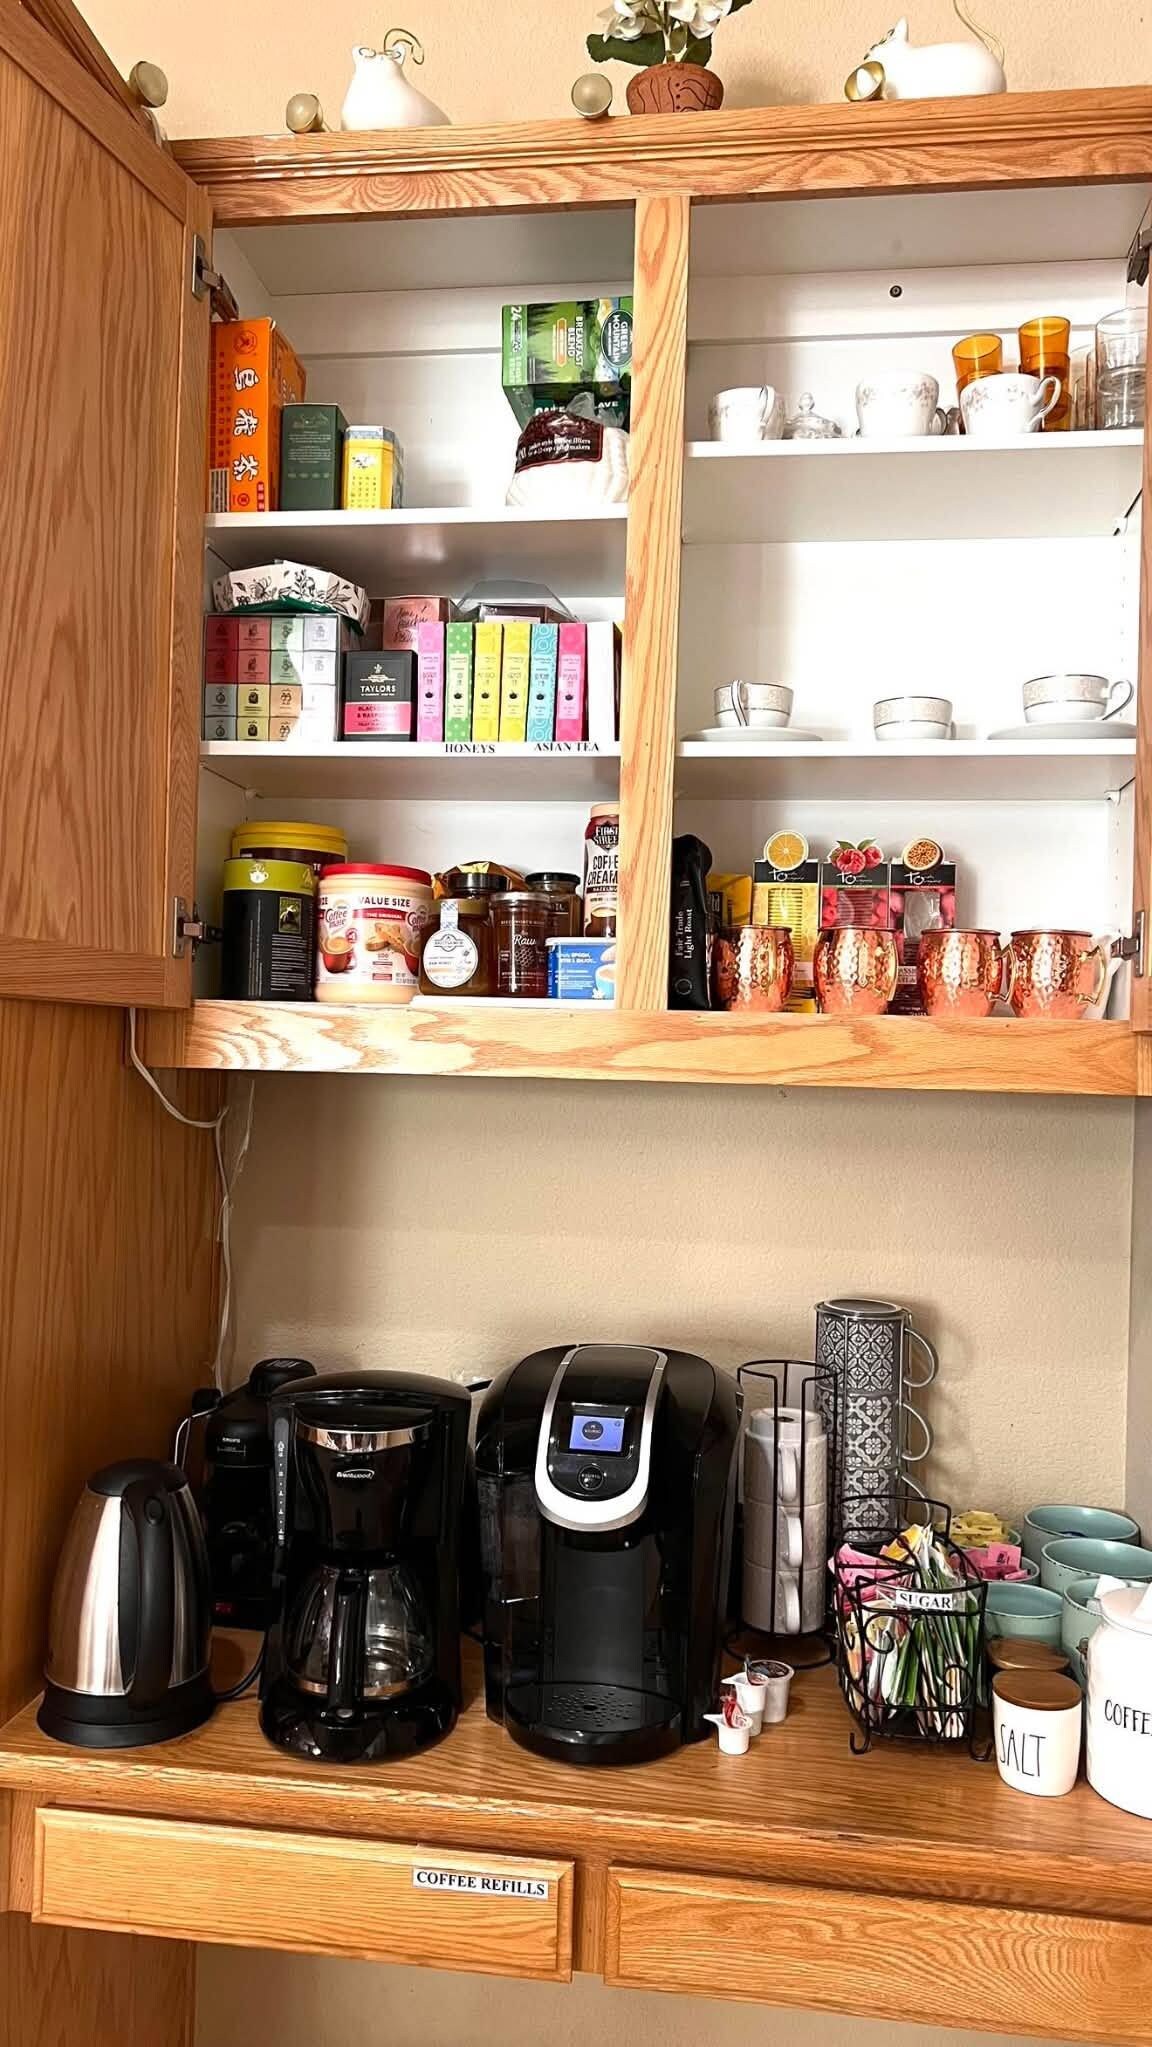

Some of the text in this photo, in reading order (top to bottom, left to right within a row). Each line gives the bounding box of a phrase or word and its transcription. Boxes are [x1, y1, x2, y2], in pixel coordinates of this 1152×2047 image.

[510, 305, 522, 321] 24
[575, 316, 584, 367] BREAKFAST
[613, 314, 621, 364] MOUNTAIN
[621, 321, 629, 354] GREEN
[360, 685, 397, 693] TAYLORS
[445, 743, 496, 754] HONEYS
[534, 742, 600, 752] ASIAN TEA
[360, 896, 411, 908] VALUE SIZE
[325, 908, 348, 923] Coffee
[514, 934, 537, 945] Raw
[674, 911, 684, 956] Fair Trade
[684, 908, 695, 959] Light Roast
[336, 1469, 375, 1479] Brentwood
[898, 1591, 951, 1610] SUGAR
[1104, 1699, 1152, 1736] COFFE
[998, 1723, 1047, 1778] SALT
[416, 1871, 546, 1896] COFFEE REFILLS
